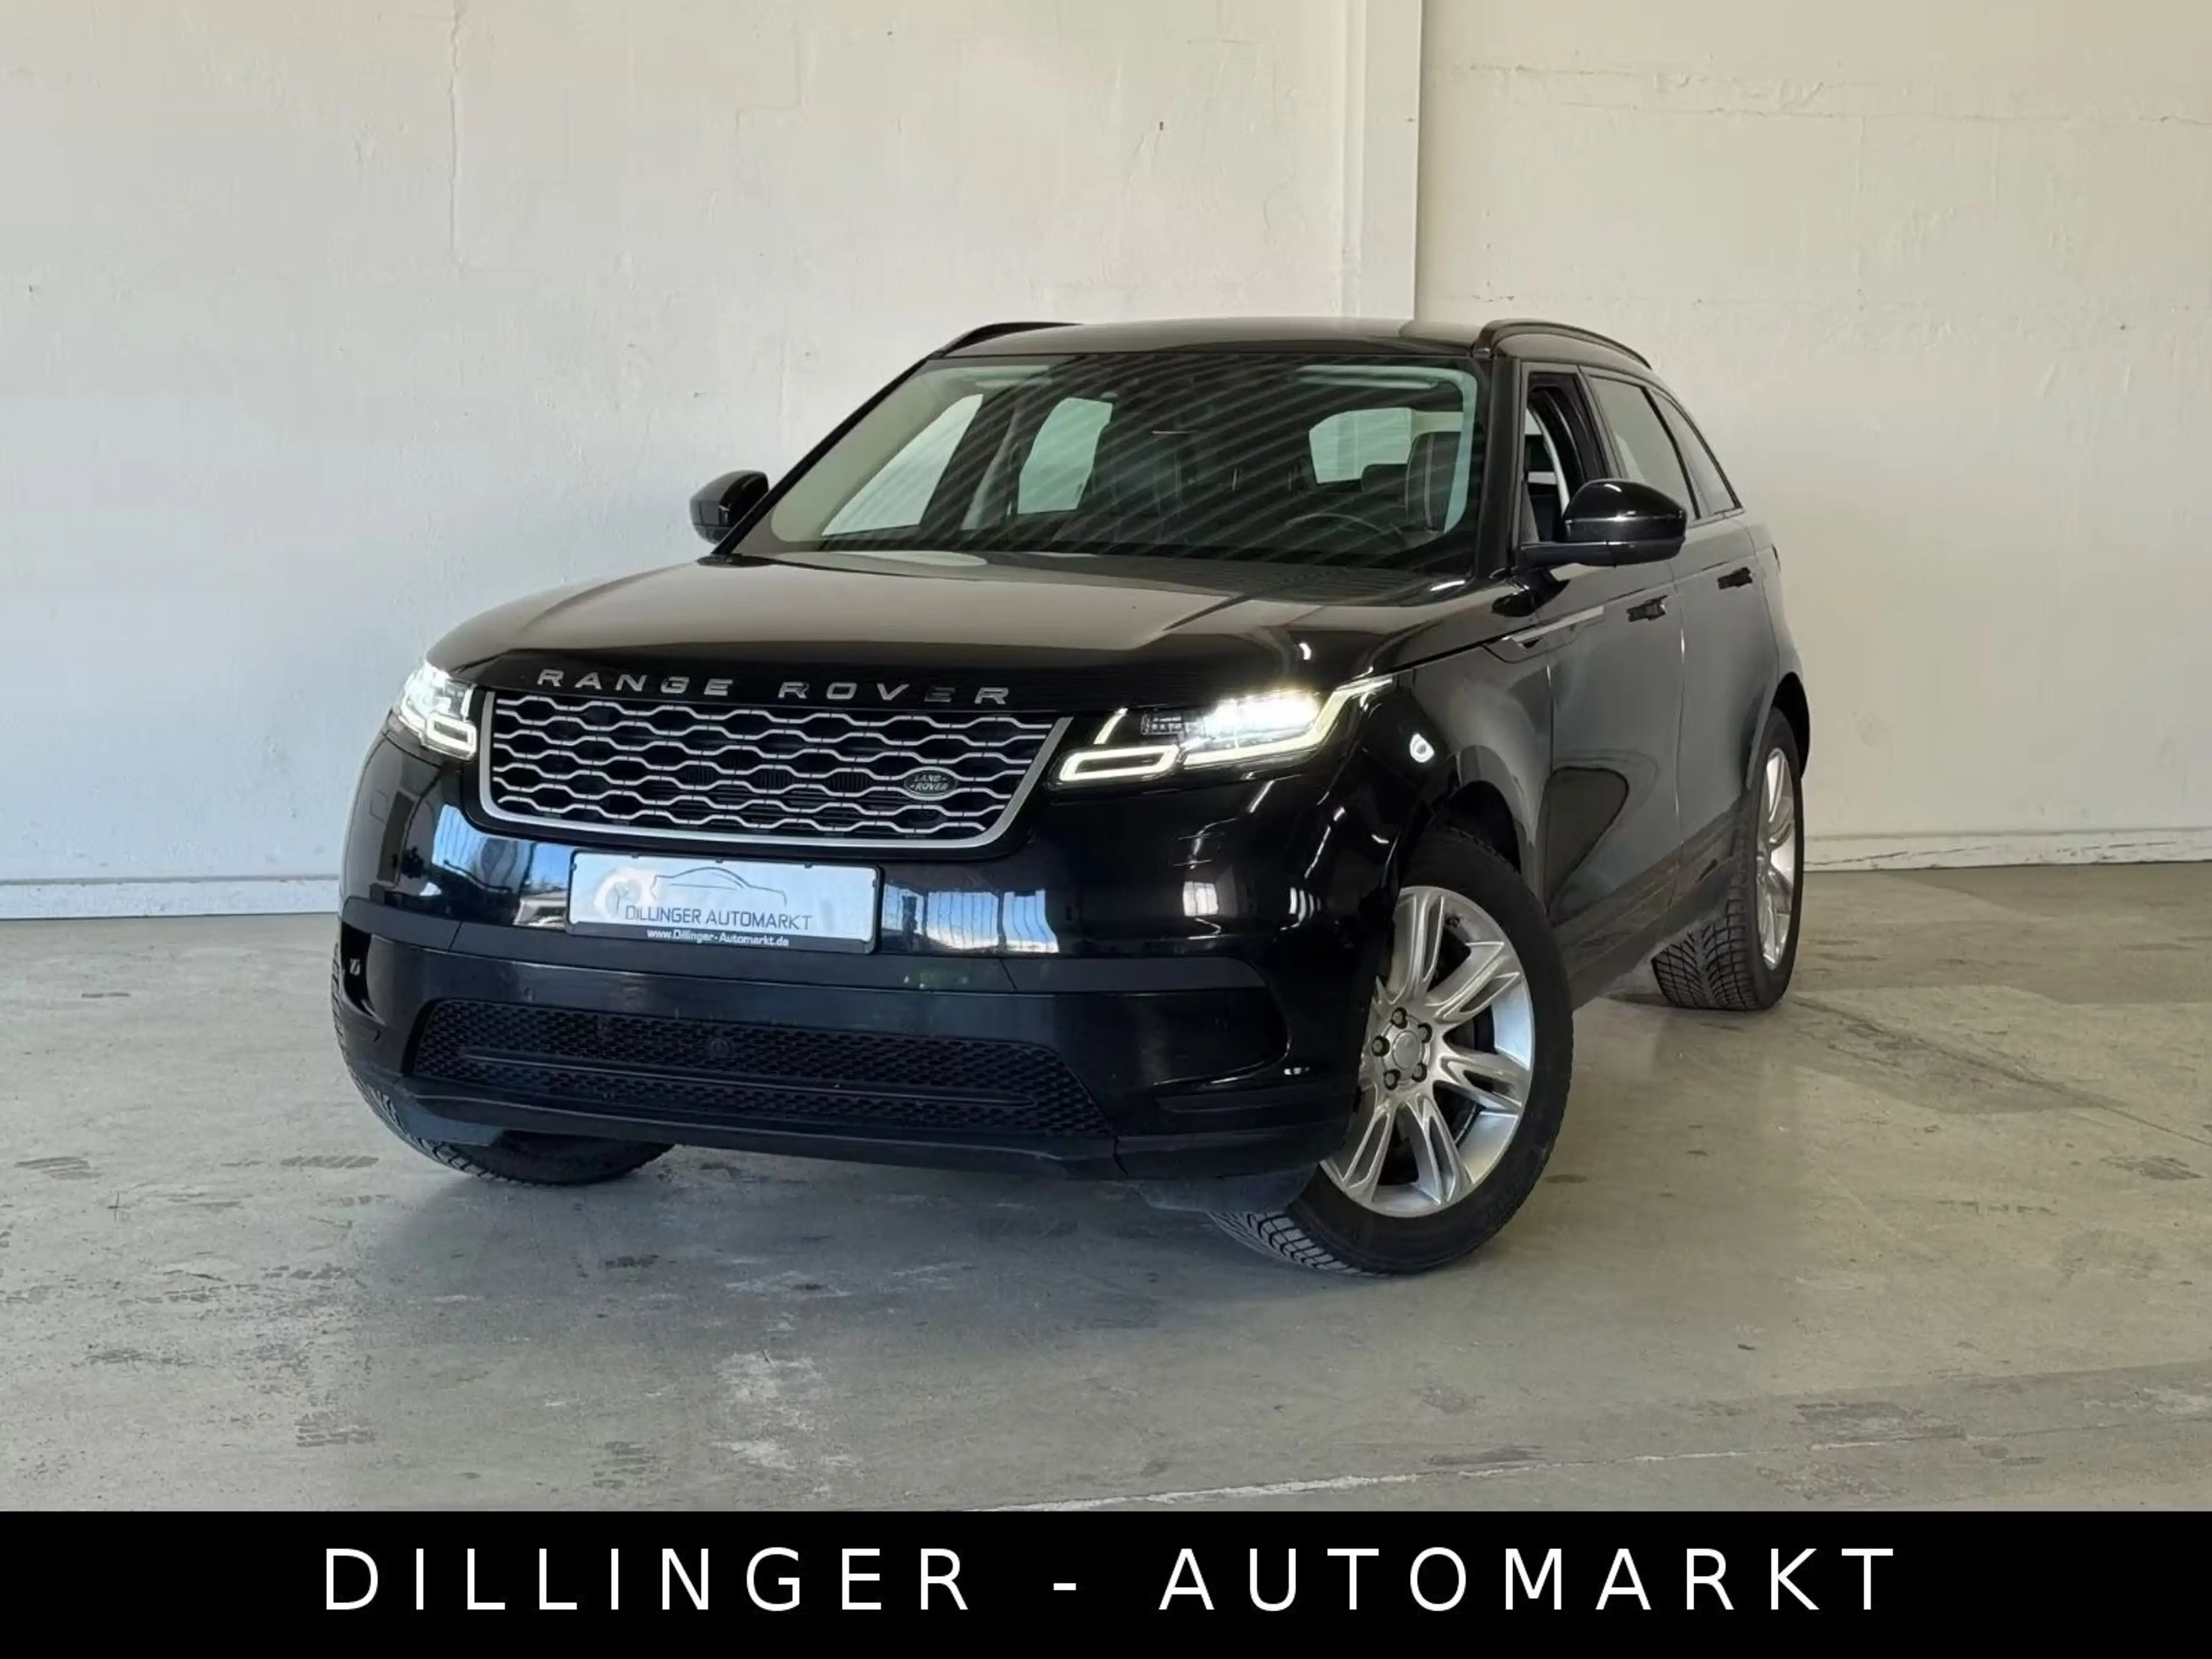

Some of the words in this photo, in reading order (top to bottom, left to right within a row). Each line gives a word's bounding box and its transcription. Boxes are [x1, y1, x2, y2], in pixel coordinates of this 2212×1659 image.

[537, 669, 734, 696] RANGE
[778, 681, 1010, 705] ROVER
[624, 905, 702, 925] DILLINGER
[704, 908, 813, 930] AUTOMARKT
[646, 929, 790, 947] www.Dillinger-Automarkt.de
